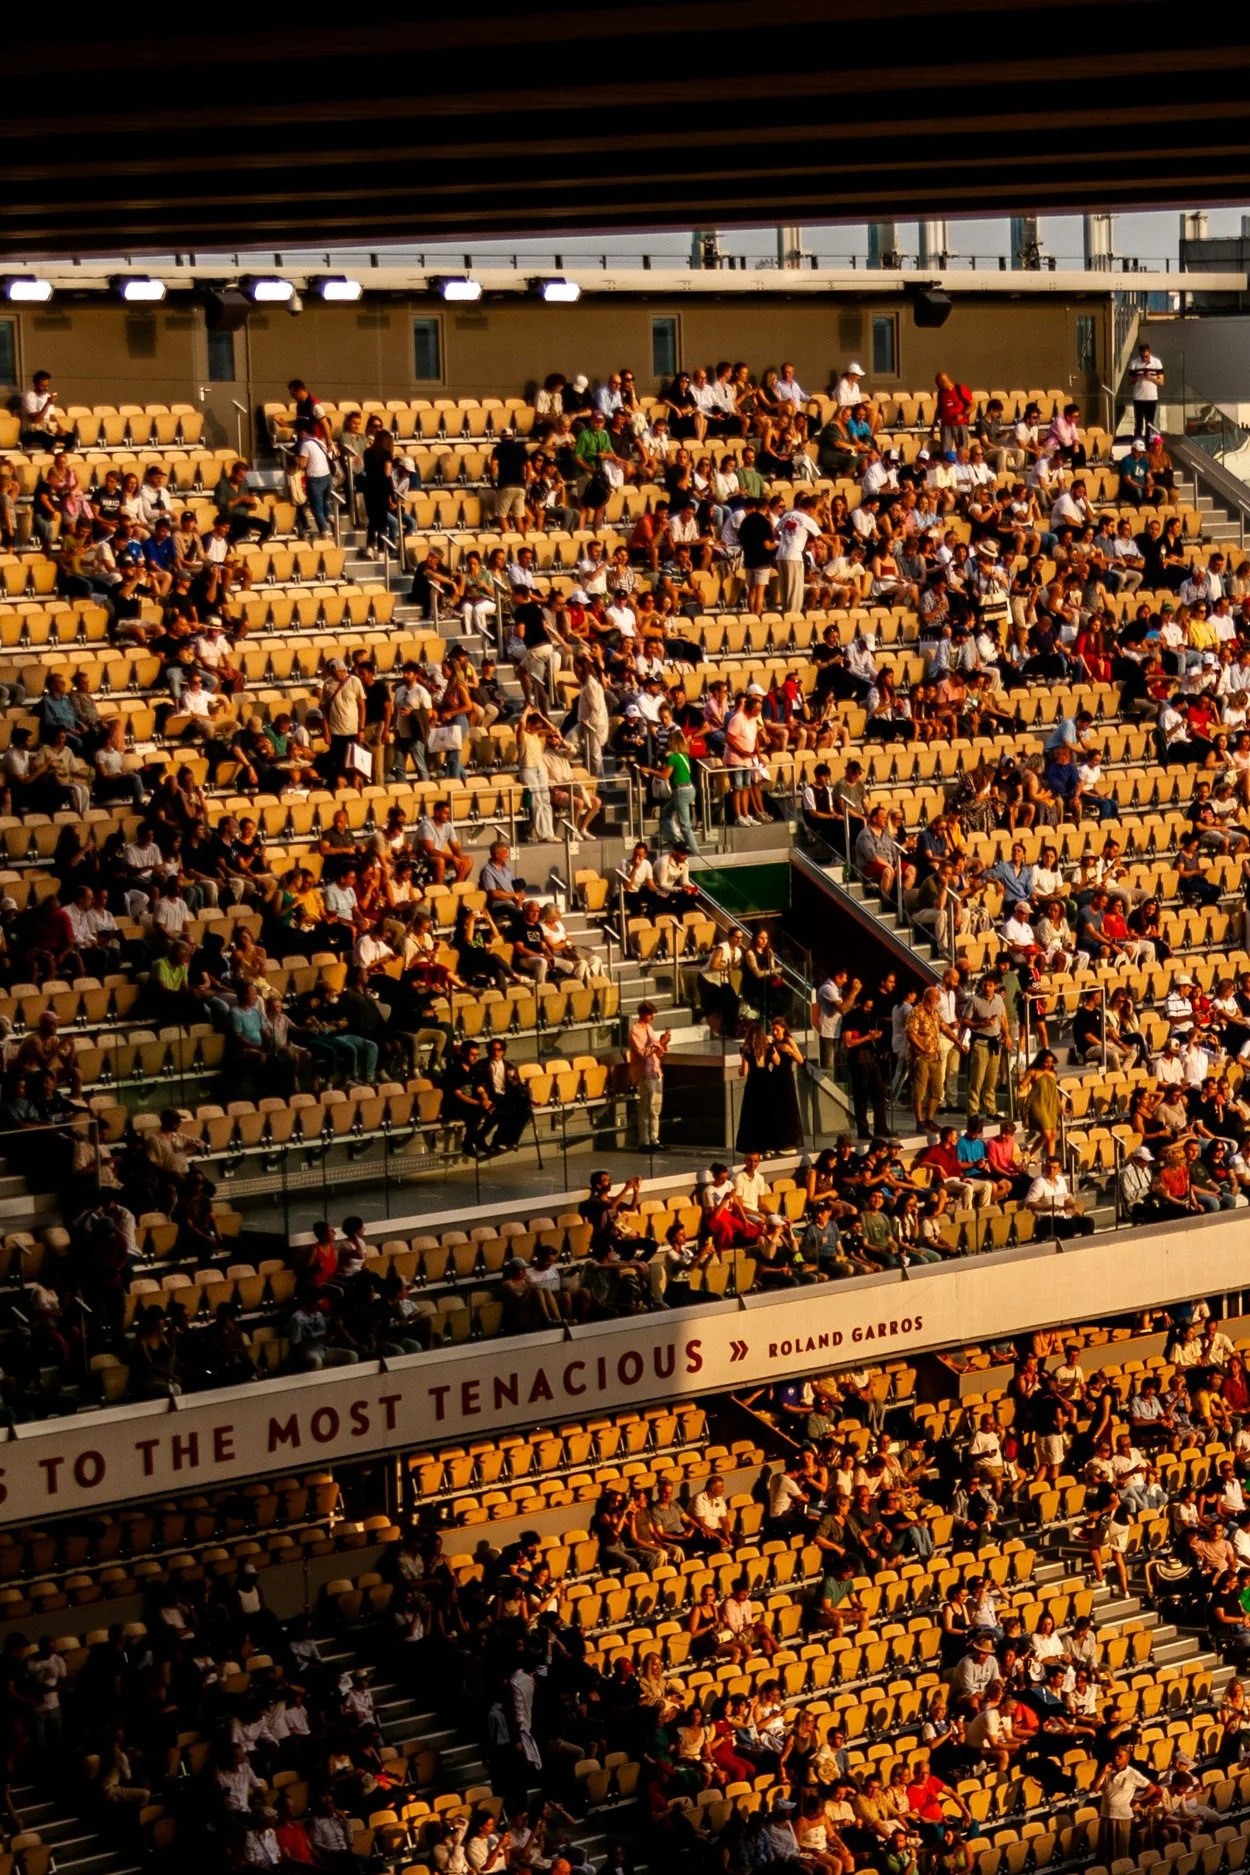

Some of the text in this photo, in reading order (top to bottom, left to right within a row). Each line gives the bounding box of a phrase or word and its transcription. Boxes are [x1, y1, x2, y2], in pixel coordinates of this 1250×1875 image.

[768, 1315, 924, 1359] ROLAND GARROS
[39, 1451, 106, 1495] TO
[135, 1425, 236, 1477] THE
[267, 1394, 403, 1453] MOST
[427, 1339, 704, 1421] TENACIOUS
